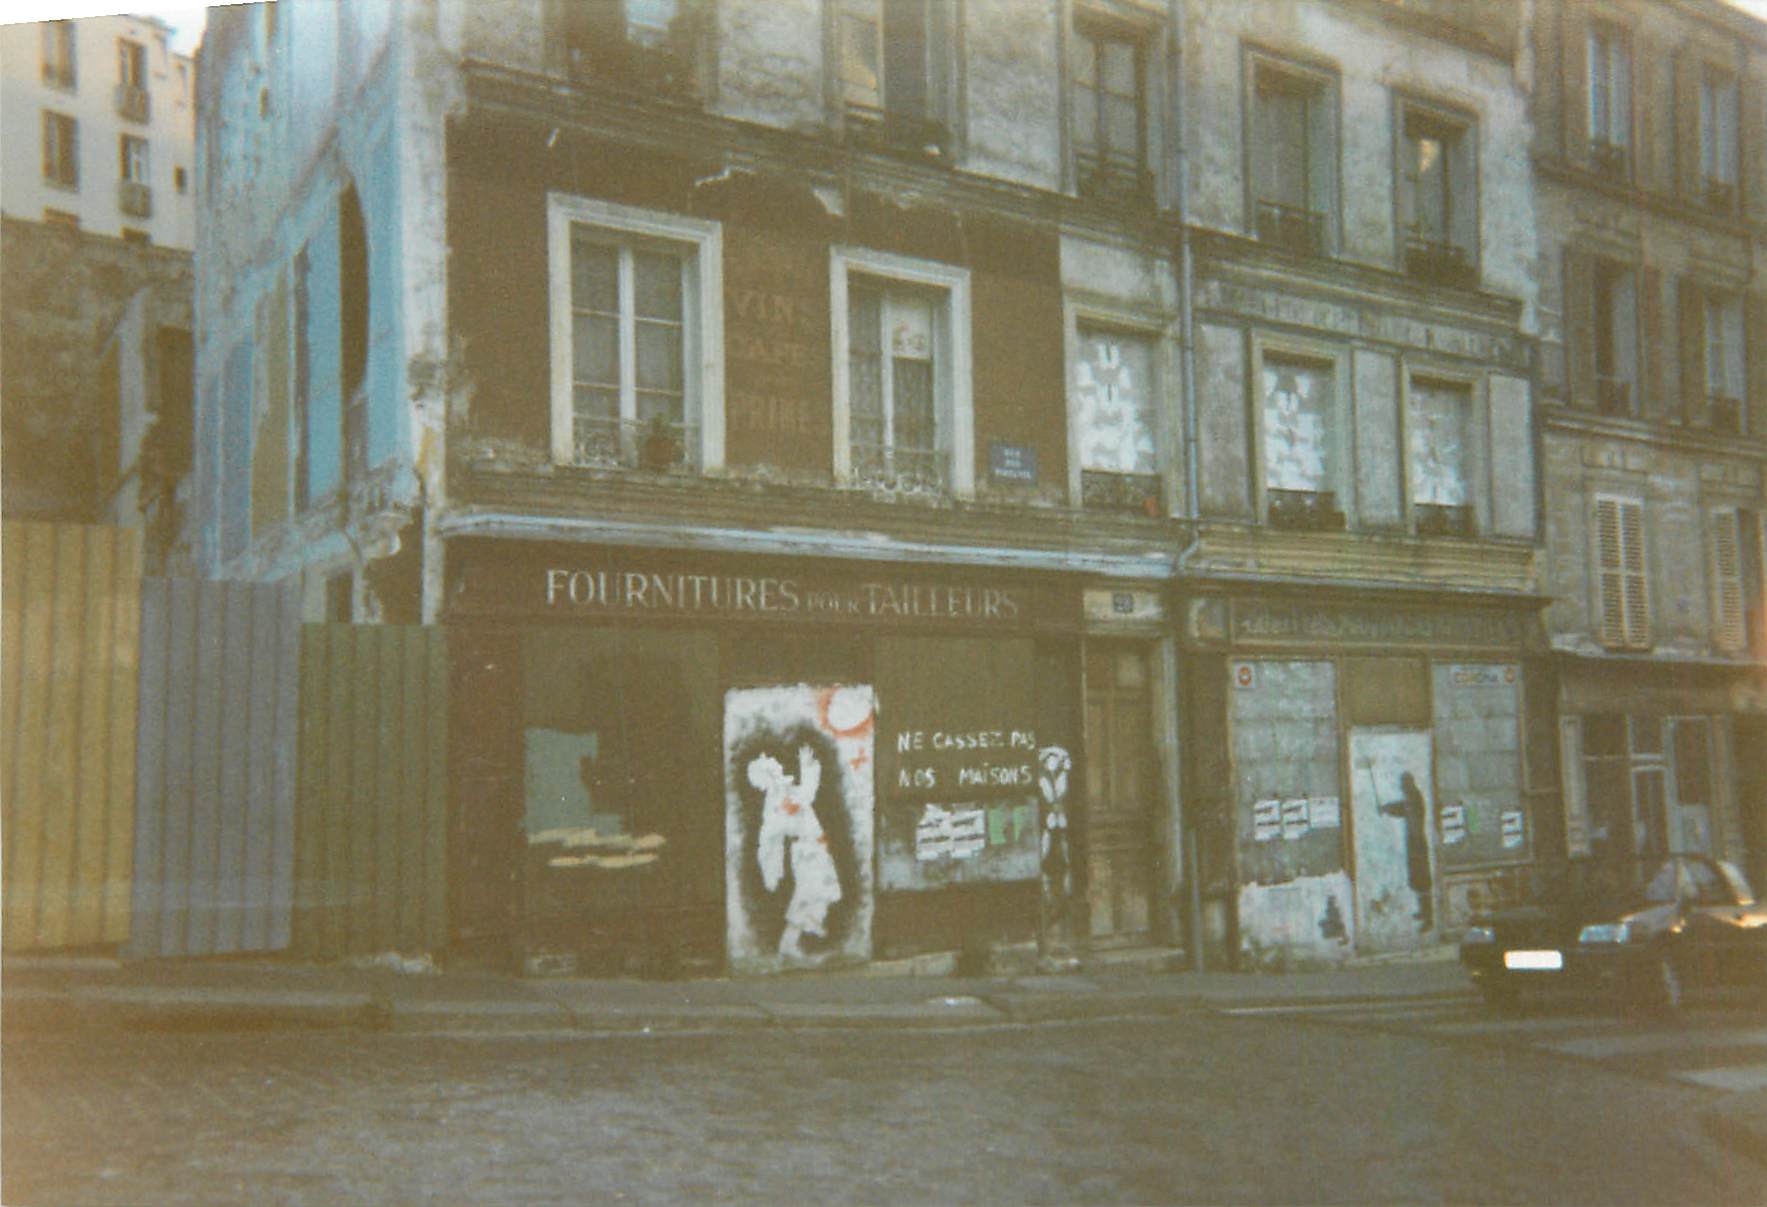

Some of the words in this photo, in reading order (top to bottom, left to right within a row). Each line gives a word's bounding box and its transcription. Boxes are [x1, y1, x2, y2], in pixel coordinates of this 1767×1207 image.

[546, 569, 799, 611] FOURNITURES
[863, 584, 1019, 618] TAILLEURS
[897, 731, 924, 753] NE
[933, 732, 1004, 750] CASSEZ
[1010, 731, 1035, 751] PAS
[898, 767, 935, 788] NOS
